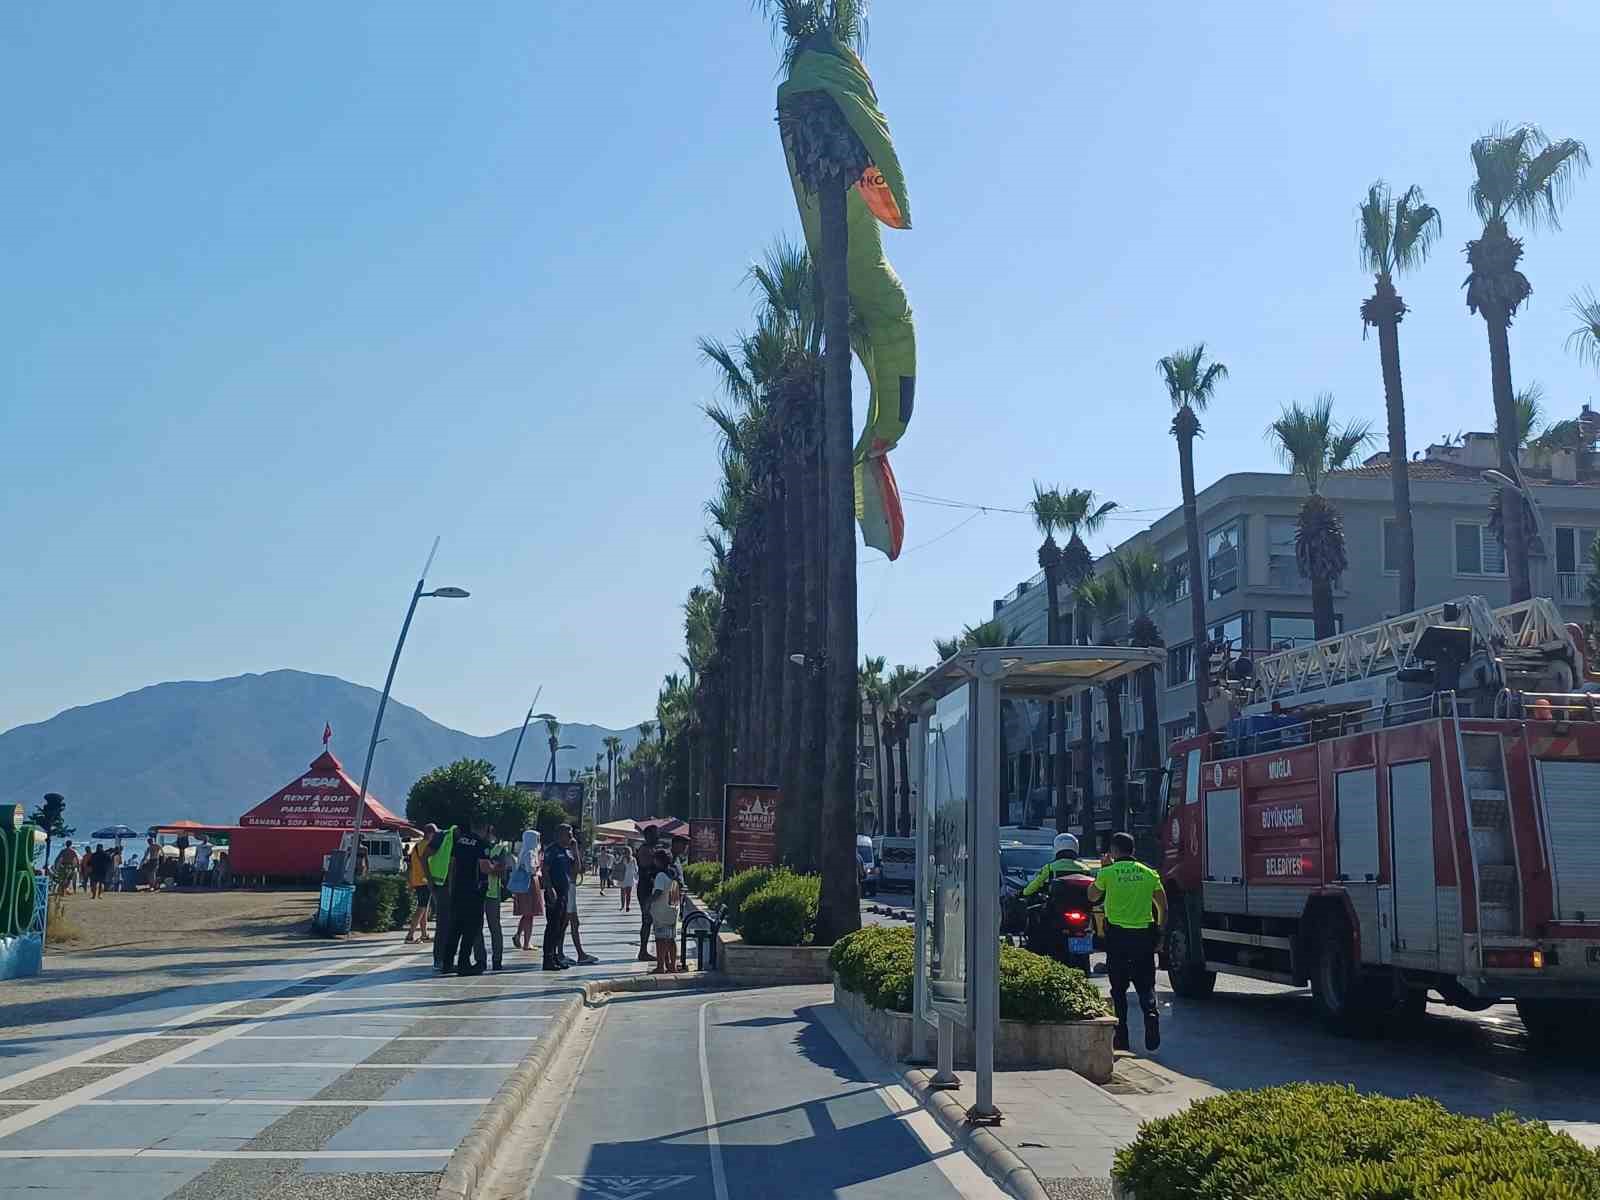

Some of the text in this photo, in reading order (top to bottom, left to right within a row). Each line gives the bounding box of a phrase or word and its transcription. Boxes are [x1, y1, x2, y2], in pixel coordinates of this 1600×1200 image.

[1268, 757, 1292, 778] MUĞLA
[280, 806, 349, 814] PARASAILING
[1262, 803, 1304, 831] BÜYÜKŞEHİR
[1266, 855, 1304, 876] BELEDİYESİ
